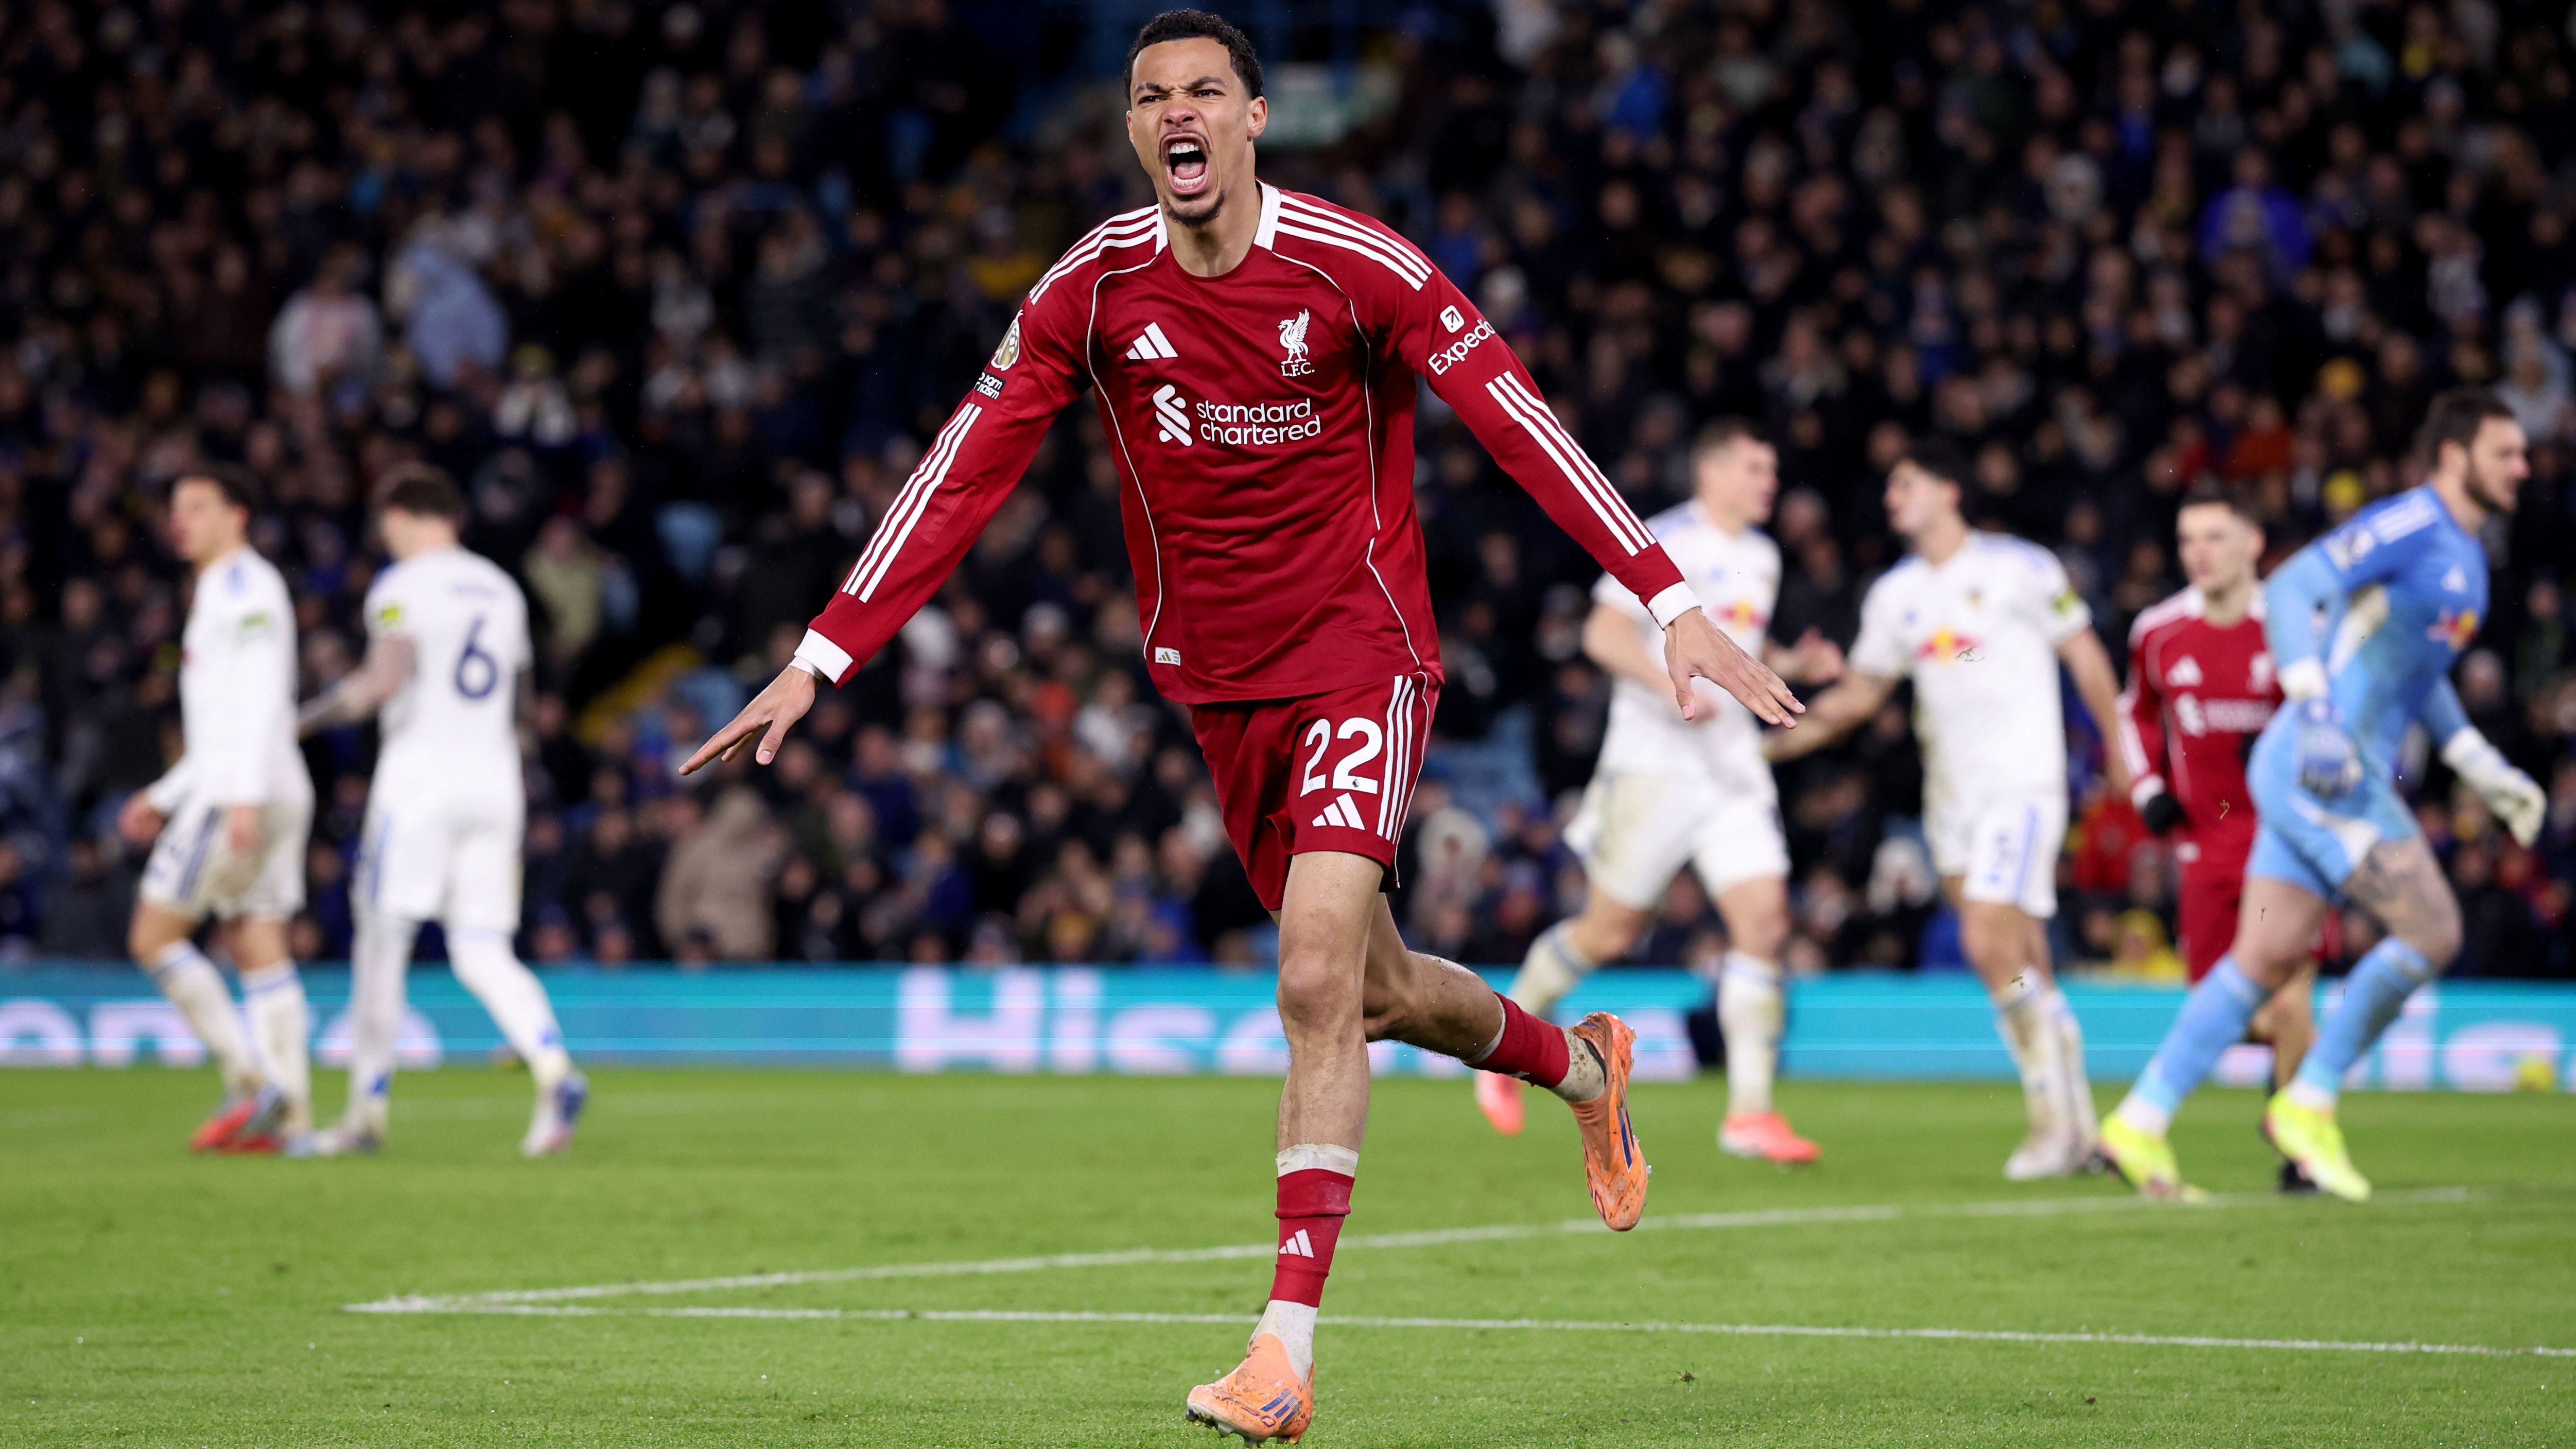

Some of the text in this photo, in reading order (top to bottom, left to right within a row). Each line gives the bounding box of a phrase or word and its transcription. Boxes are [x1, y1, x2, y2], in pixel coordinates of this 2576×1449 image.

[1280, 362, 1315, 377] L.F.C.
[1196, 397, 1311, 423] standard
[1200, 414, 1321, 445] chartered
[454, 610, 498, 701] 6
[1299, 717, 1383, 798] 22
